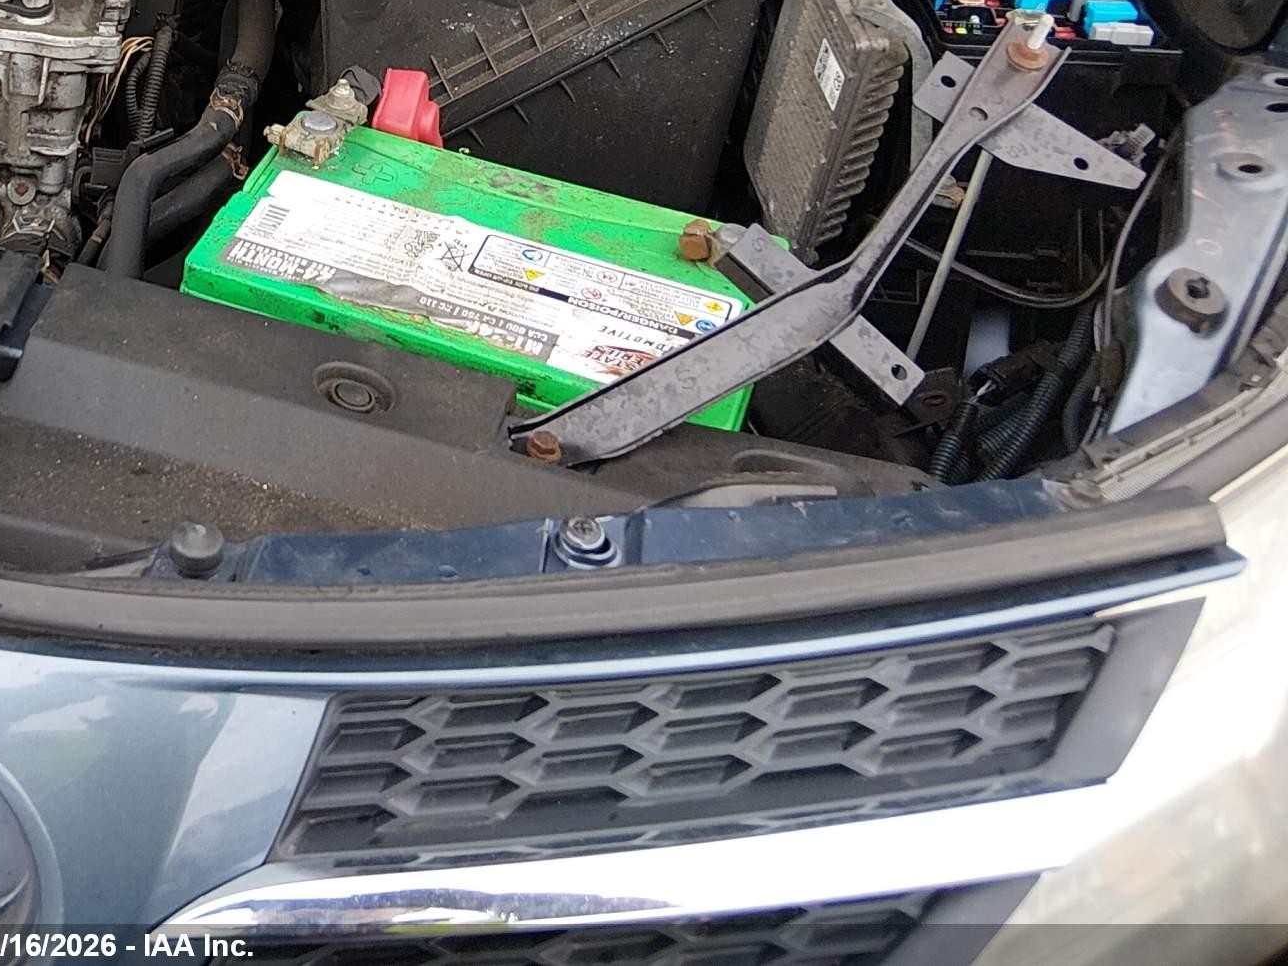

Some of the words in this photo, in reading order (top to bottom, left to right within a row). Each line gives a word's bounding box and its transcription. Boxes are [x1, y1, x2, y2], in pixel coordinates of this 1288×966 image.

[565, 296, 680, 334] DANGER/POISON
[596, 324, 667, 350] OMOTIVE
[580, 349, 637, 371] STATE
[592, 344, 644, 364] ERIES
